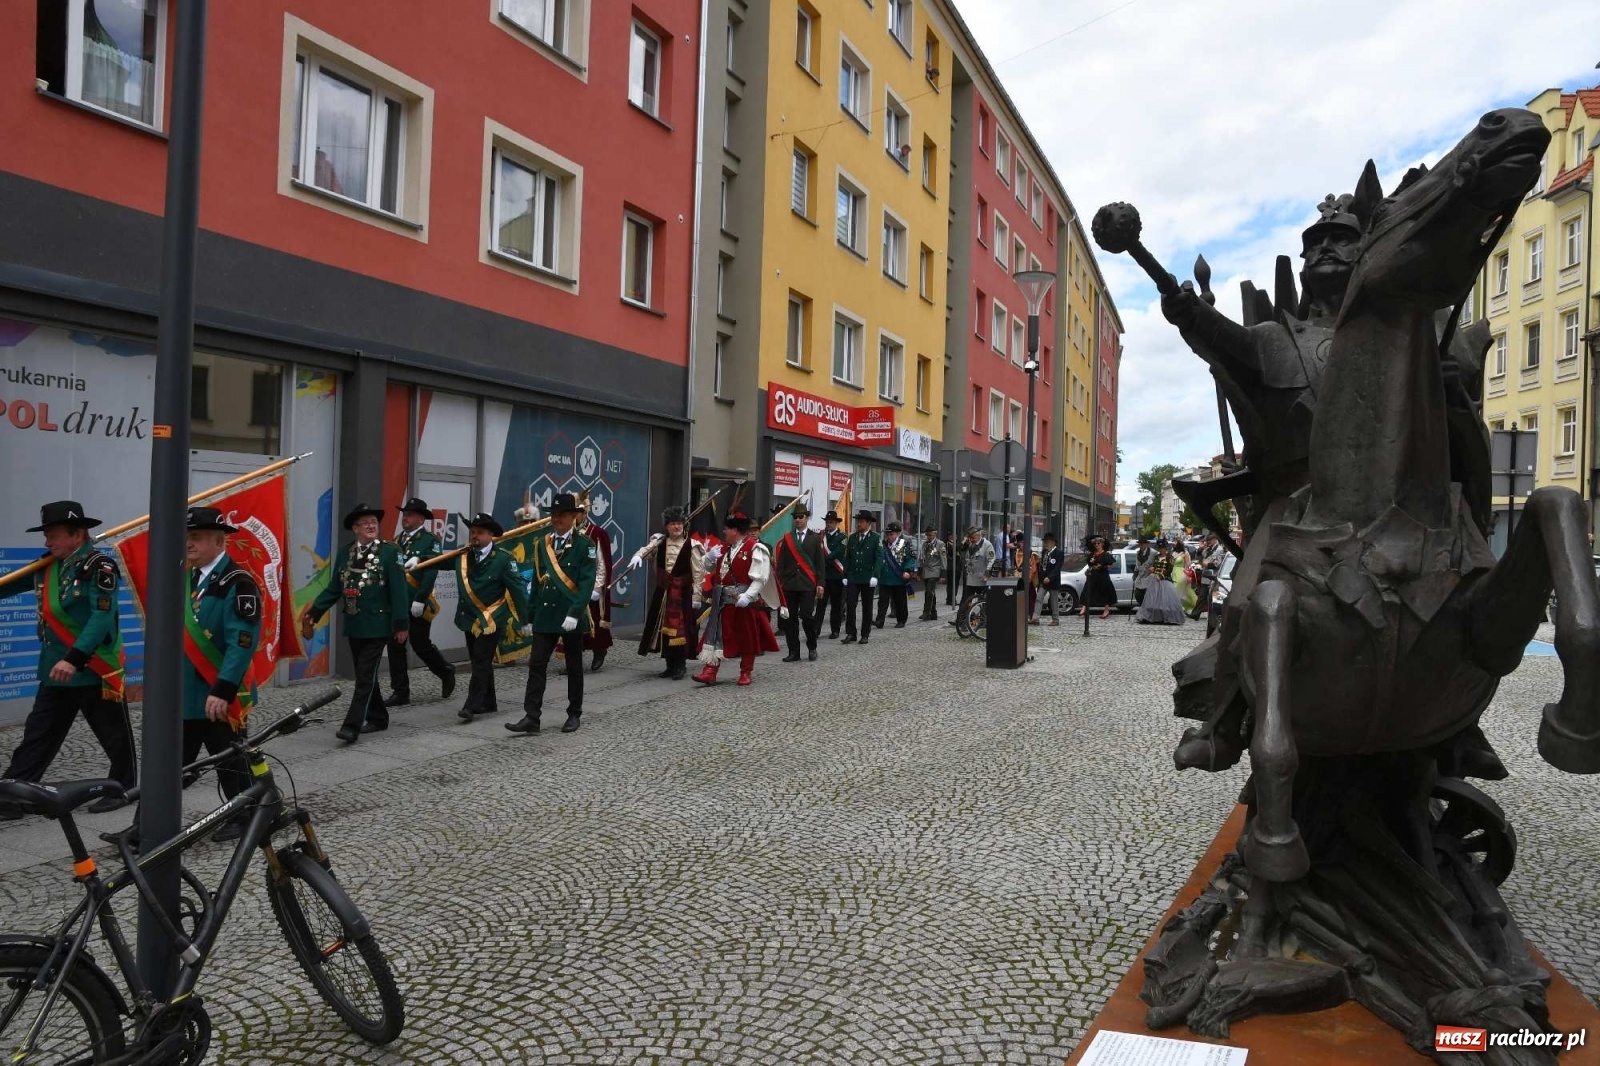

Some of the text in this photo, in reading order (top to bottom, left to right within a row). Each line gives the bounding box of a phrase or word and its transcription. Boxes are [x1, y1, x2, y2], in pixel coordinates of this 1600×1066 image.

[797, 397, 849, 425] AUDIO-SŁUCH
[548, 454, 571, 465] OPC UA
